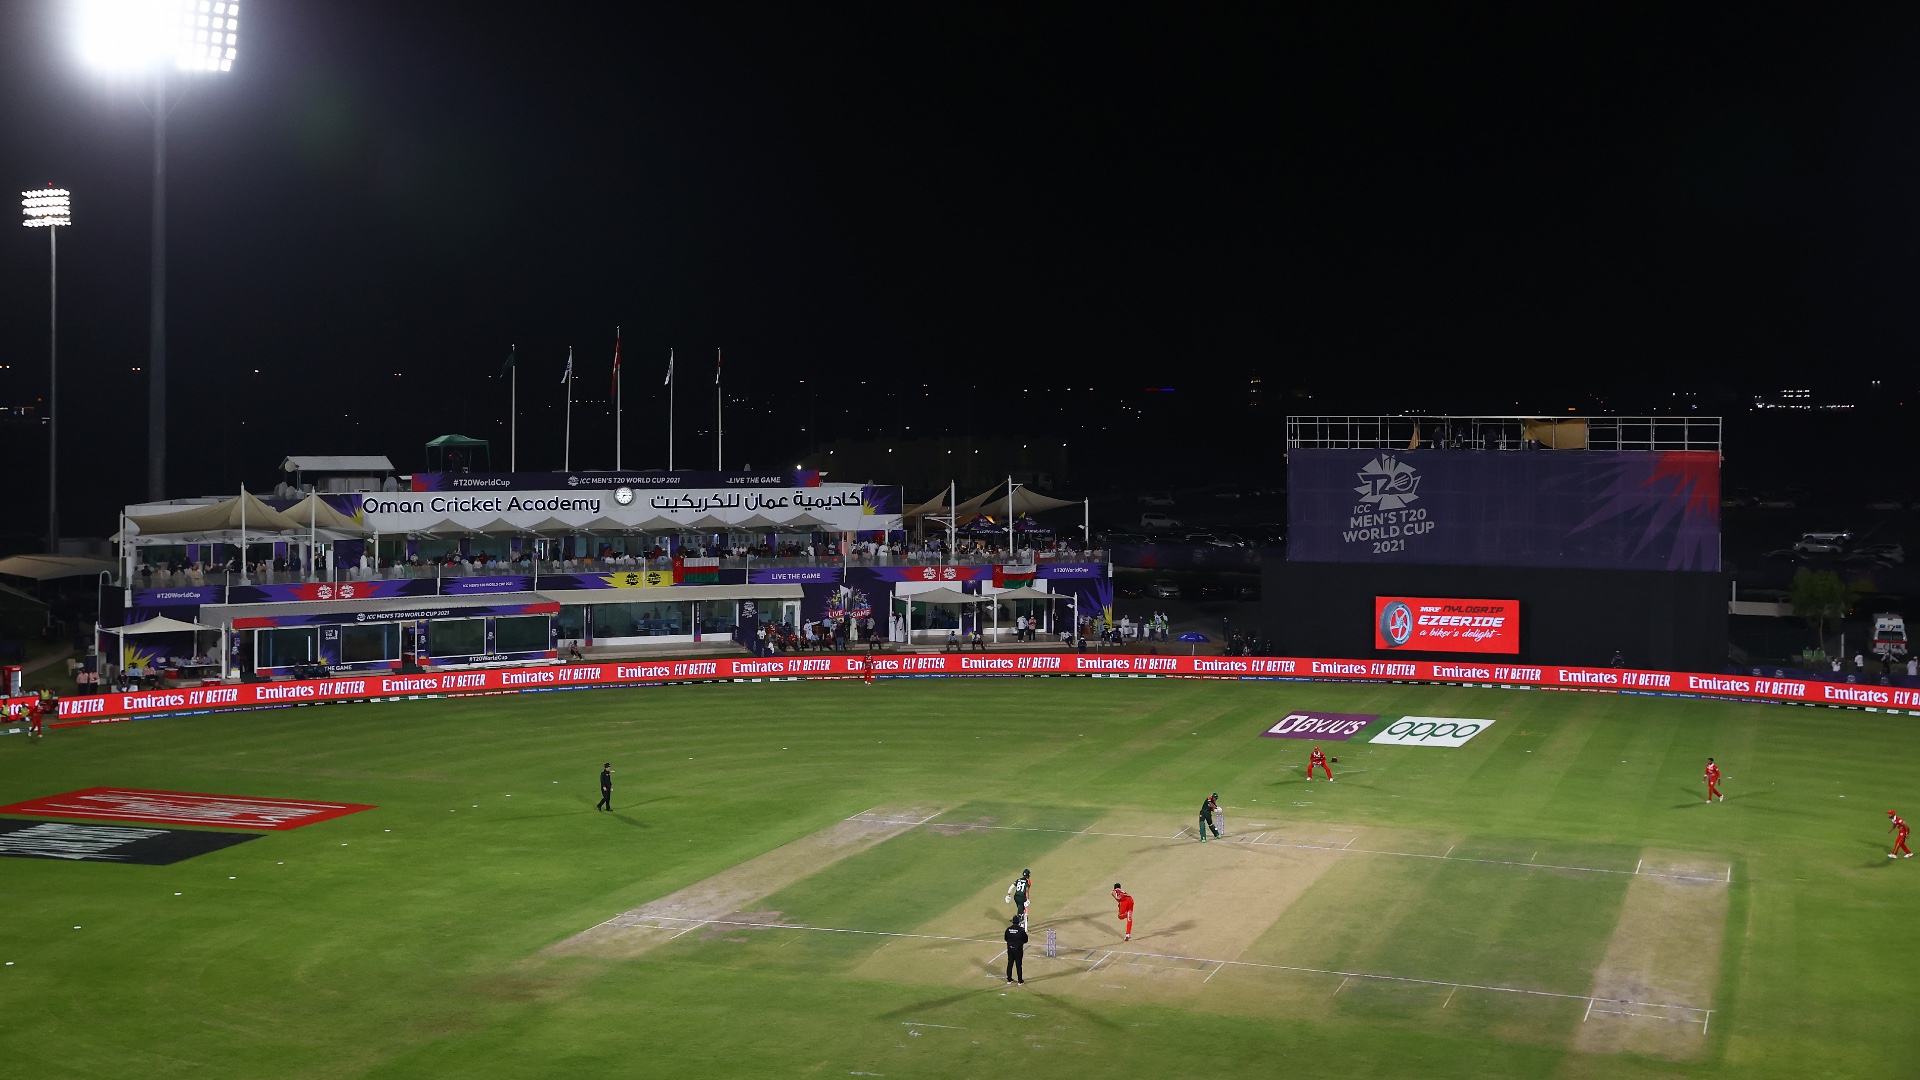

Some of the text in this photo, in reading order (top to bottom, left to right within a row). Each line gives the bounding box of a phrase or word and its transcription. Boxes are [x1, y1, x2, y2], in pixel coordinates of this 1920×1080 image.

[453, 479, 511, 488] #T20WorldCup
[760, 476, 781, 484] GAME
[363, 496, 601, 515] Oman Cricket Academy
[650, 488, 865, 513] أكاديمية عمان للكريكيت
[1353, 504, 1371, 514] ICC
[1350, 508, 1427, 528] MEN'S T20
[1342, 521, 1435, 543] WORLD CUP
[1373, 539, 1405, 554] 2021
[376, 612, 394, 620] MEN'S
[828, 610, 843, 618] LIVE
[851, 609, 871, 618] GAME
[1442, 605, 1504, 614] NYLOGRIP
[1417, 615, 1505, 627] EZEERIDE
[1429, 627, 1459, 638] biker's
[1461, 628, 1498, 642] delight
[732, 660, 830, 673] Emirates FLY BETTER
[847, 658, 945, 671] Emrates FLY BETTER
[962, 657, 1060, 668] Emirates FLY BETTER
[1077, 657, 1177, 669] Emirates FLY BETTER
[1194, 660, 1295, 672] Emirates FLY BETTER
[1312, 662, 1415, 675] Emirates FLY BETTER
[502, 668, 600, 684] Emirates FLY BETTER
[618, 663, 716, 678] Emirates FLY BETTER
[1433, 666, 1541, 680] Emirates FLY BETTER
[1559, 670, 1670, 686] Emirates FLY BETTER
[257, 681, 364, 699] Emirates FLY BETTER
[383, 674, 485, 691] Emirates FLY BETTER
[1689, 676, 1805, 696] Emirates FLY BETTER
[123, 689, 237, 709] Emirates FLY BETTER
[1825, 686, 1888, 702] Emirates
[1894, 691, 1910, 704] FLY
[71, 699, 104, 714] BETTER
[1294, 718, 1367, 735] BYJU'S
[1387, 721, 1481, 742] oppo
